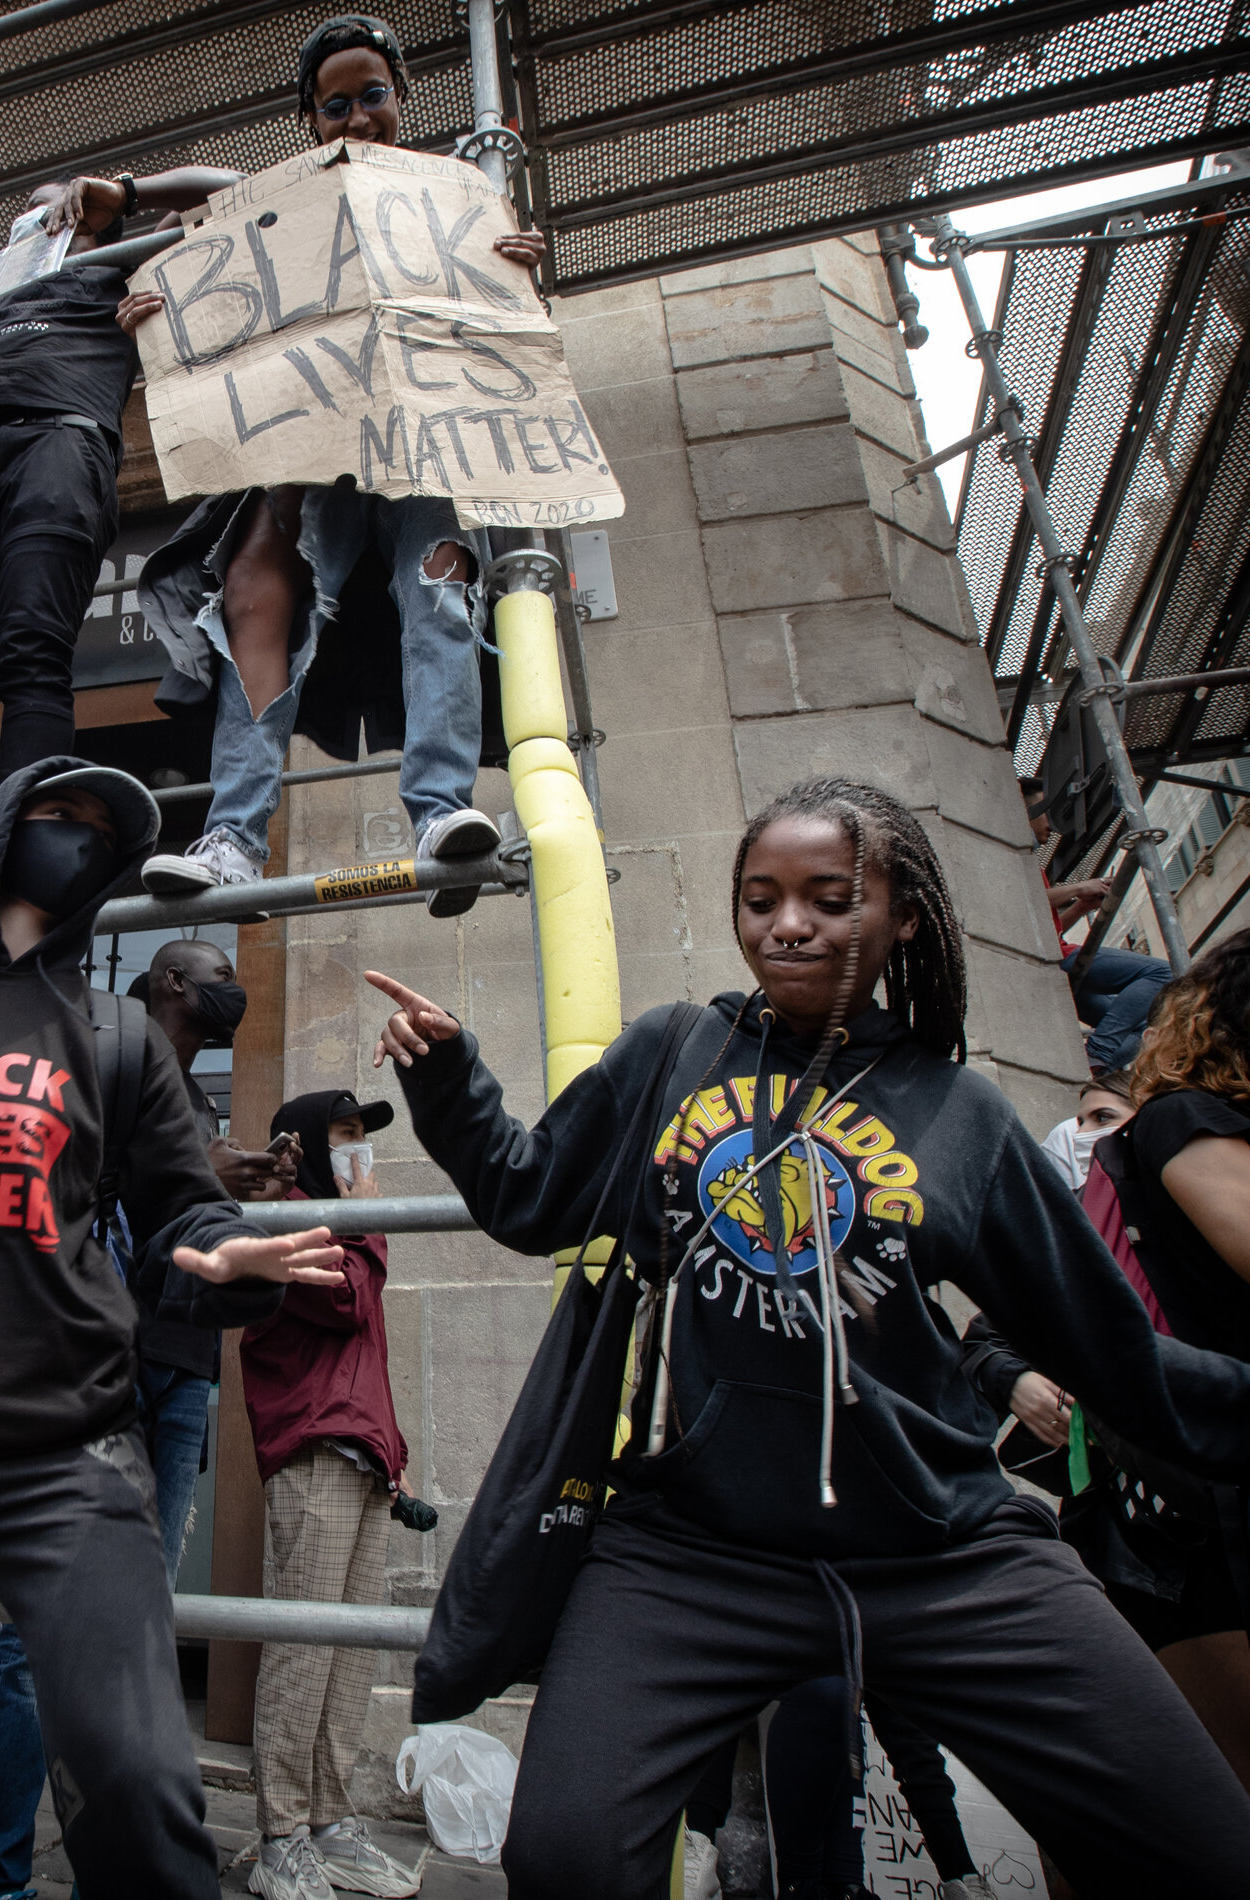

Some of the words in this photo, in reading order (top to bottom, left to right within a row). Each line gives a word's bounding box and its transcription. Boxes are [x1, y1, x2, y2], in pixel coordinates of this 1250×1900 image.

[150, 187, 526, 375] BLACK
[223, 304, 538, 447] LIVES
[359, 399, 610, 492] MATTER!
[530, 497, 595, 525] 2020
[320, 873, 413, 901] RESISTENCIA
[327, 864, 379, 883] SOMOS
[383, 861, 401, 873] LA
[654, 1085, 737, 1166] THE
